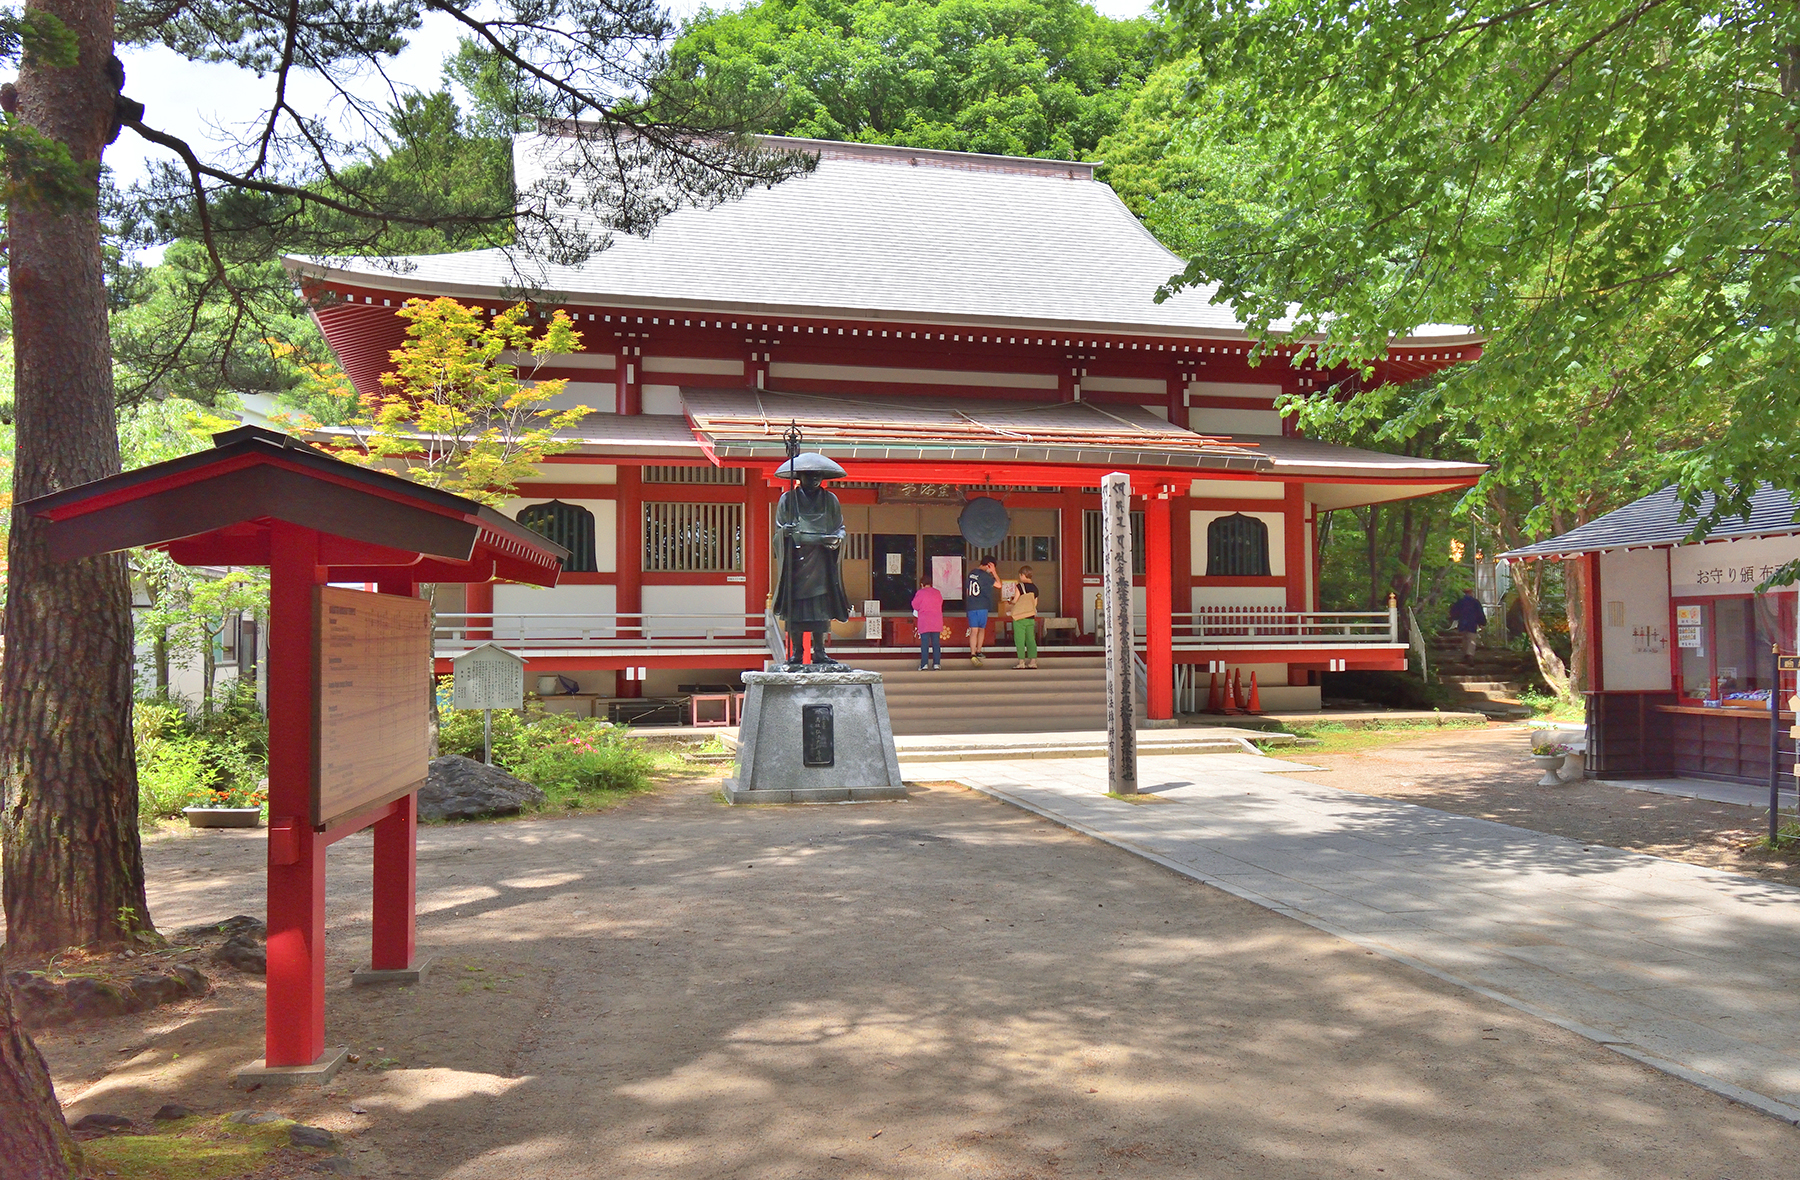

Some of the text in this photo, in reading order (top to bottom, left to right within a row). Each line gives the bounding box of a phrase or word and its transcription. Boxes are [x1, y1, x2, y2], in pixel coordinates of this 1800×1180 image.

[1697, 564, 1785, 584] お守り頒布
[969, 580, 981, 596] 10
